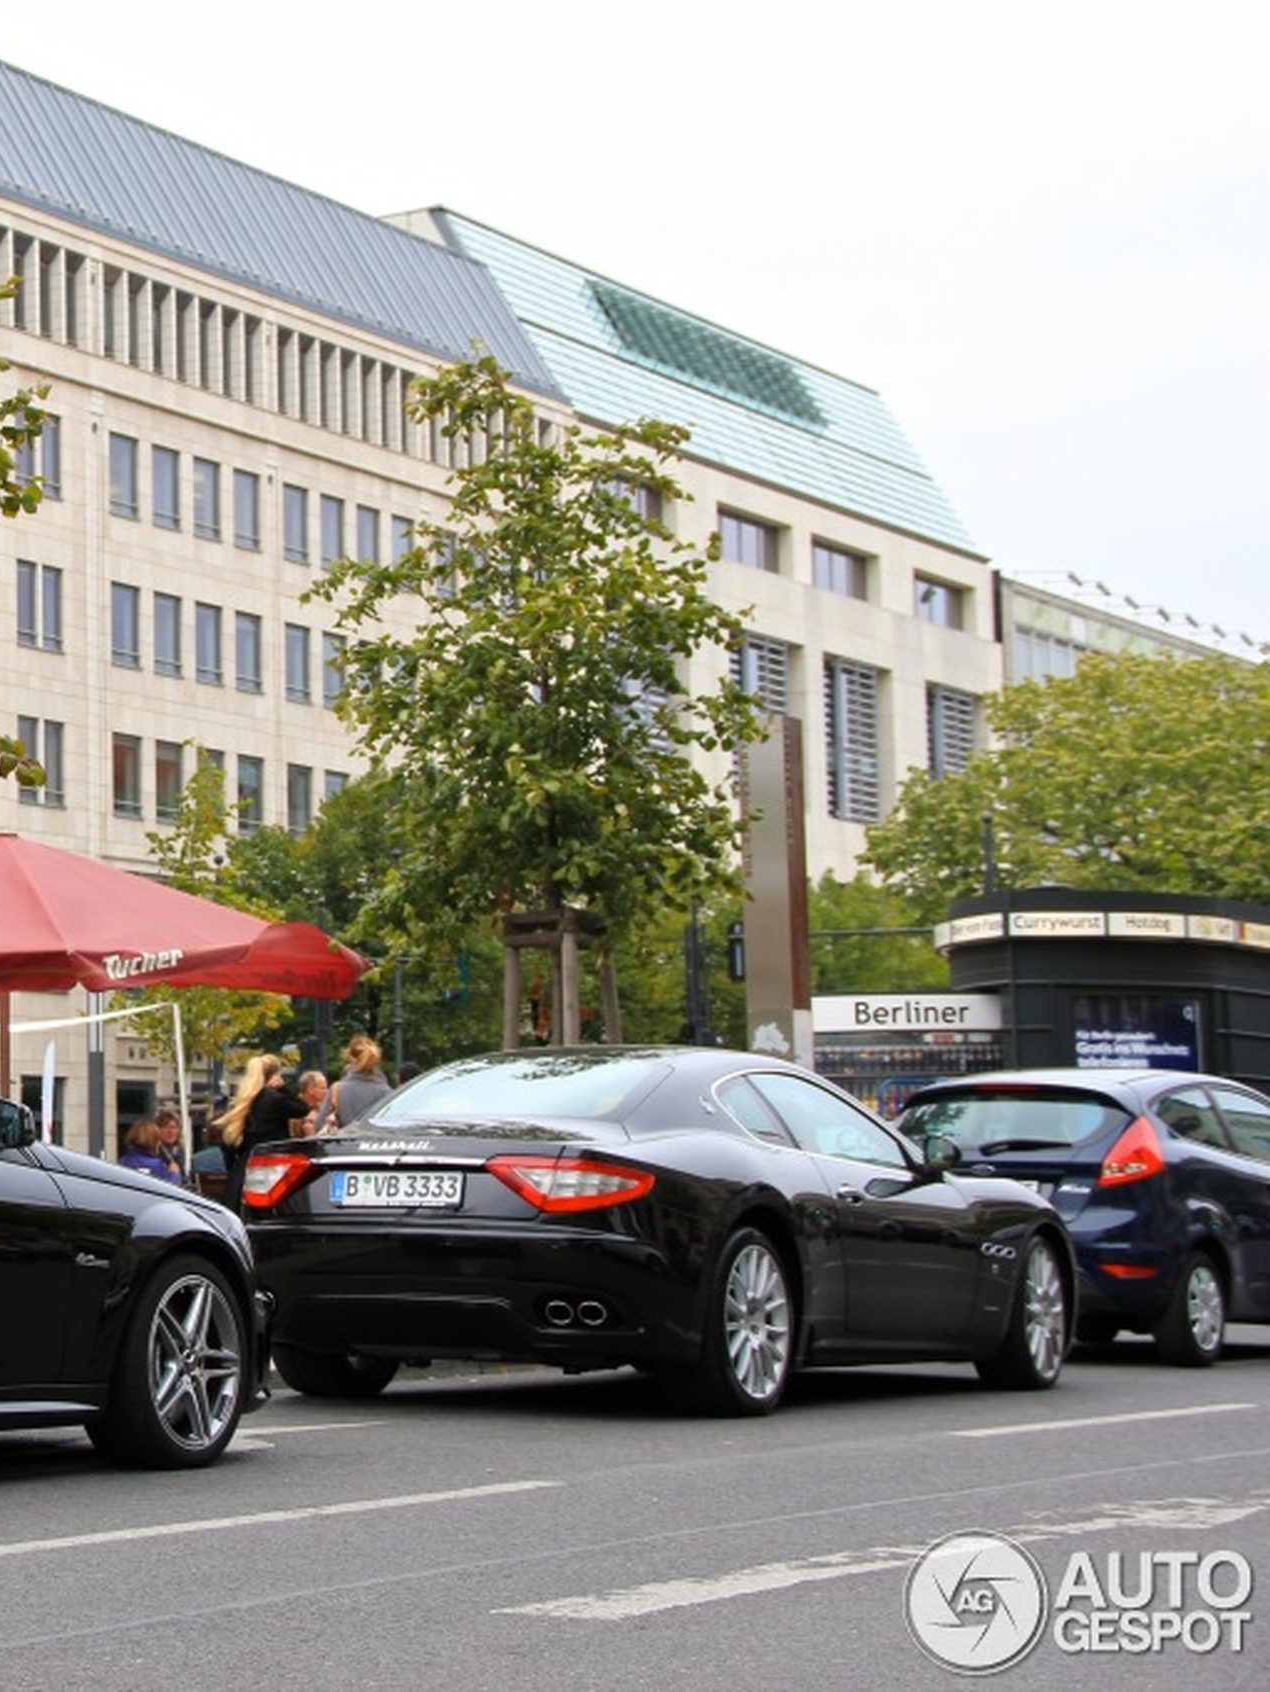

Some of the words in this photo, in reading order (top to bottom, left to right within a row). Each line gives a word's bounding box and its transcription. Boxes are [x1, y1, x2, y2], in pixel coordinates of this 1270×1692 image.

[1013, 916, 1101, 929] Currywurst
[1125, 916, 1171, 931] Hotdog
[102, 949, 184, 979] Tucher
[854, 1001, 970, 1025] Berliner
[346, 1176, 359, 1198] B
[374, 1176, 400, 1198] VB
[404, 1176, 459, 1199] 3333
